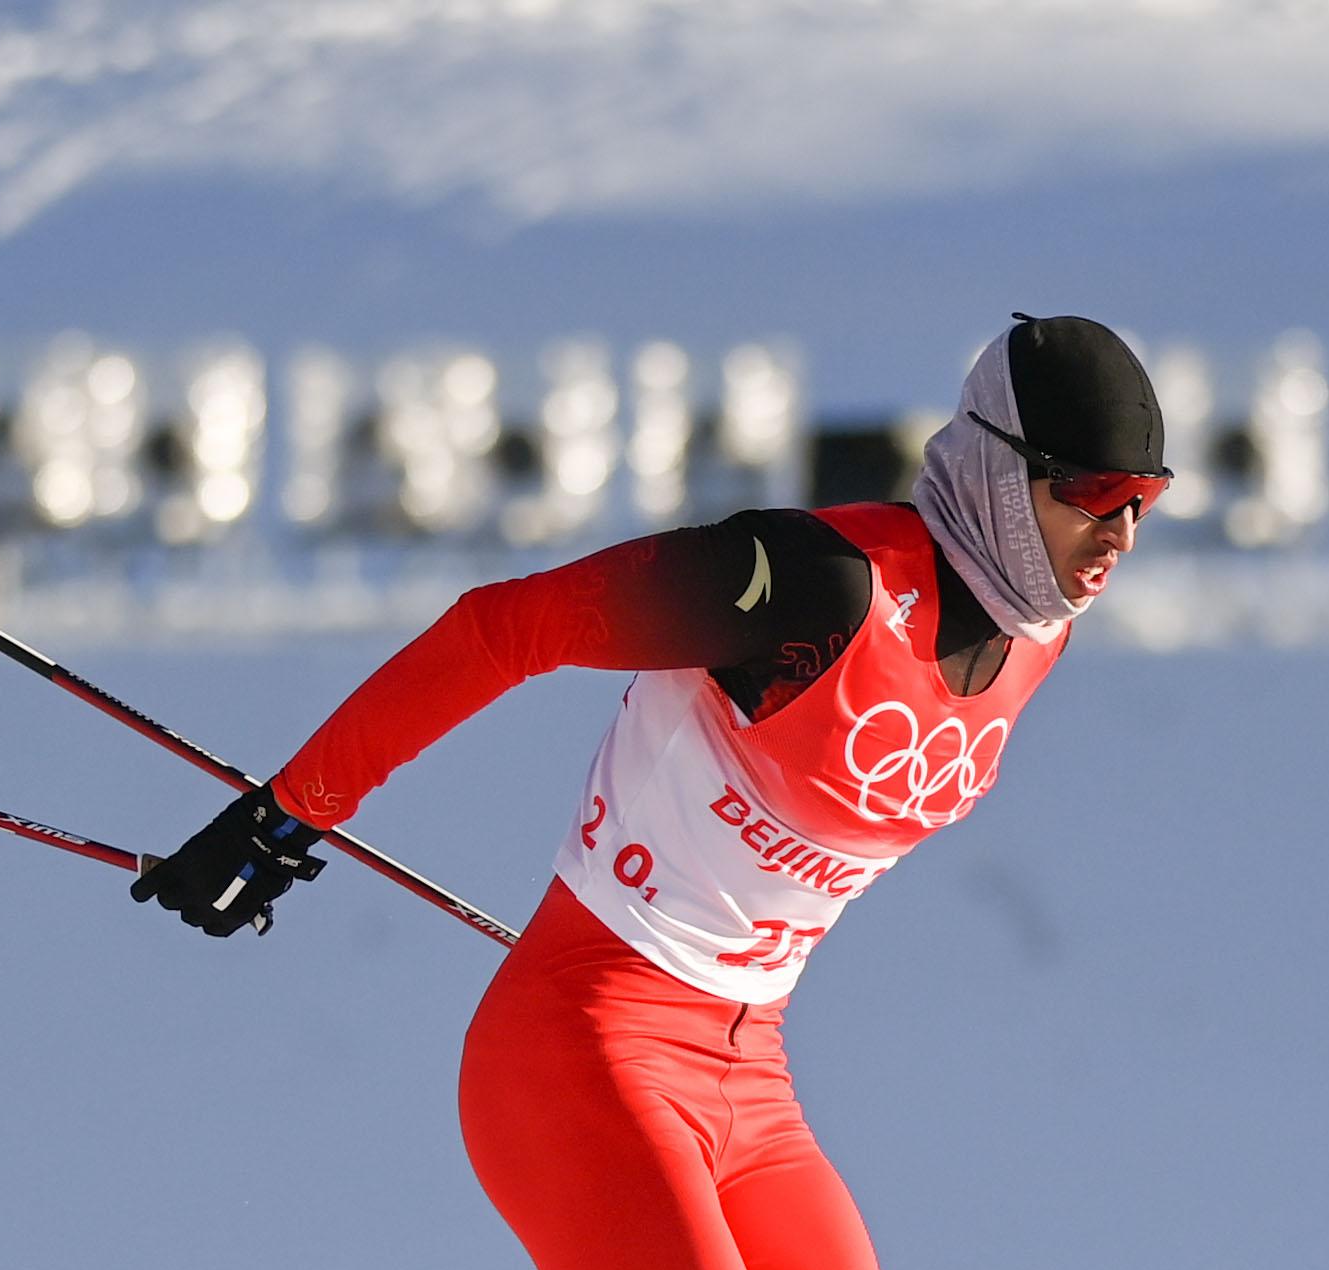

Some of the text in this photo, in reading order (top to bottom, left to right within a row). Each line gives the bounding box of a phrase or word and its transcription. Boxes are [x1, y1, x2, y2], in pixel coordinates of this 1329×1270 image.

[998, 473, 1019, 550] ELEVATE
[1008, 471, 1041, 606] ELEVATE YOUR
[709, 784, 866, 898] BEIJING
